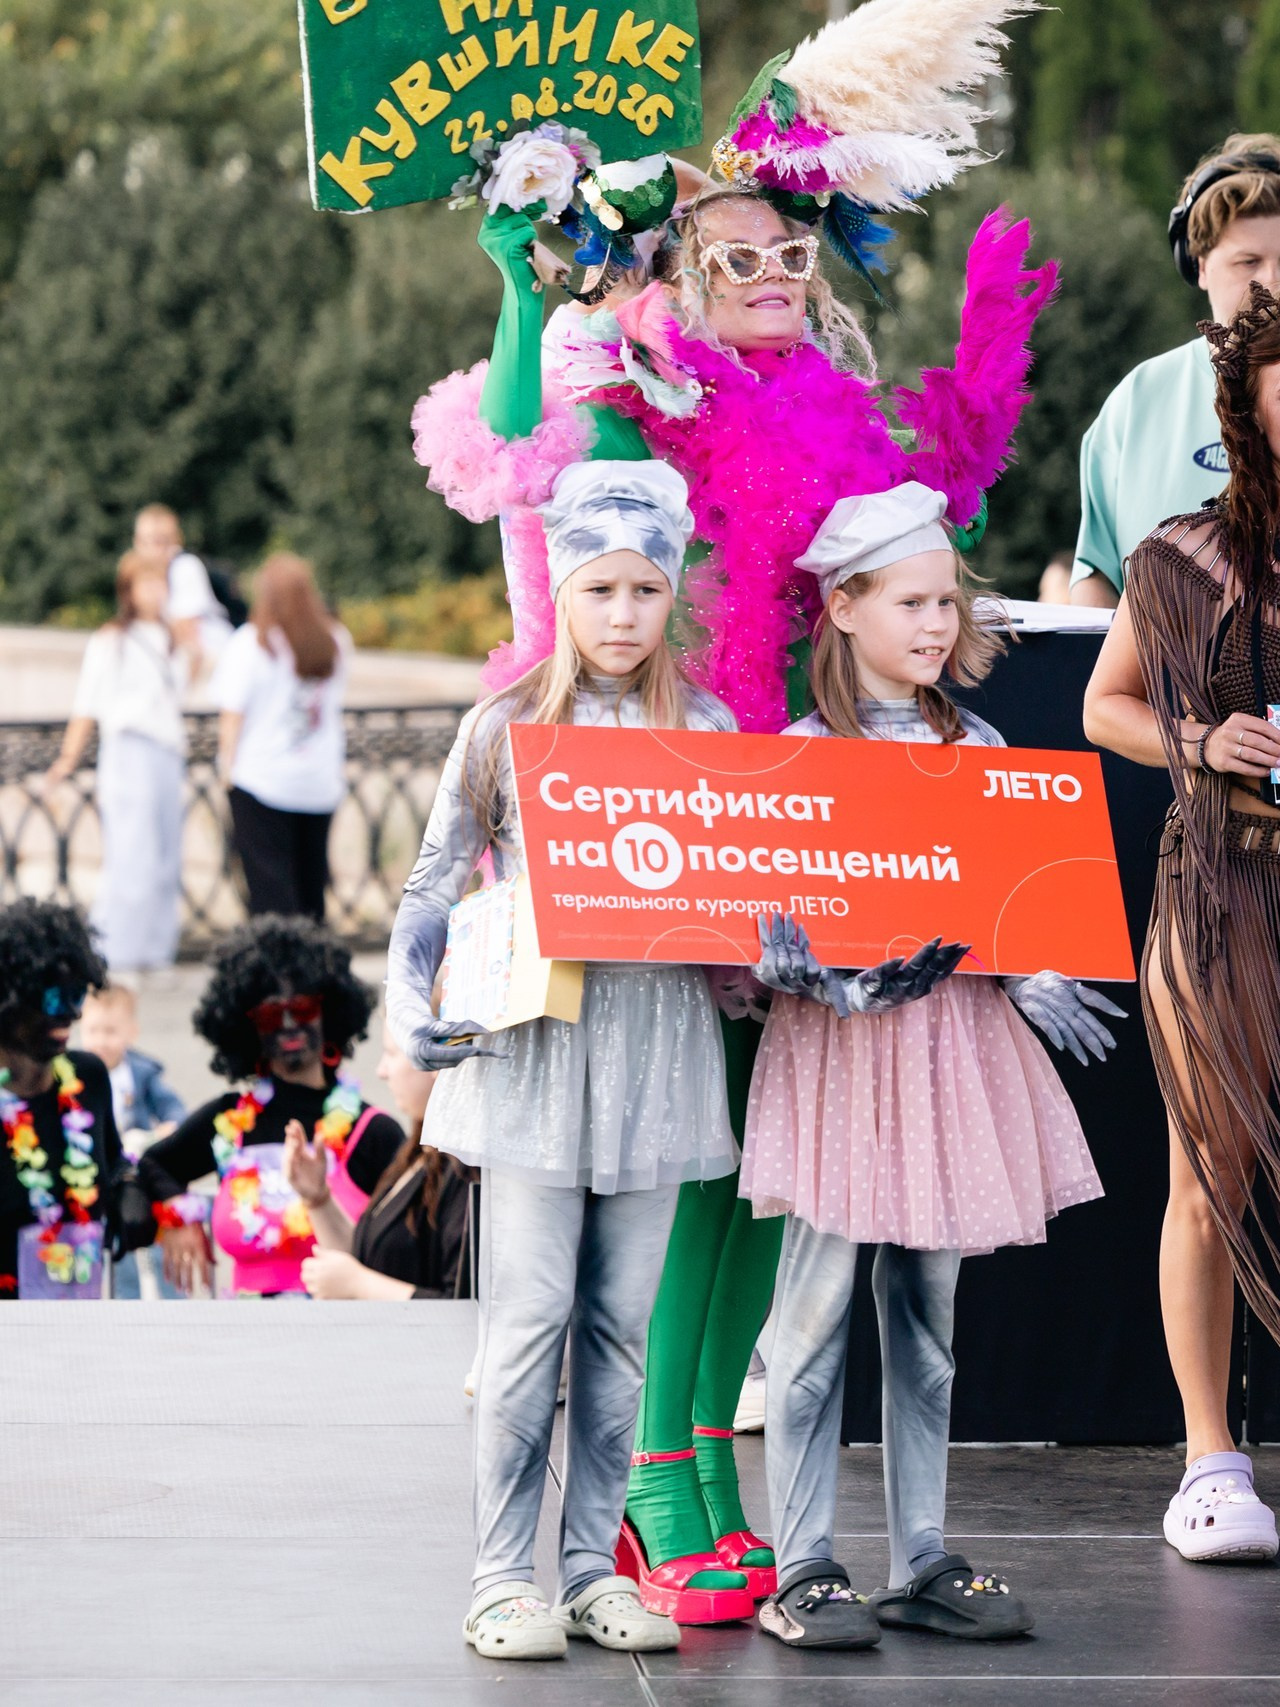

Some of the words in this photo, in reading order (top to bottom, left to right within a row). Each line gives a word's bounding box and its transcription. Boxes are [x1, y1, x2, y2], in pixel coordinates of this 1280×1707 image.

[318, 5, 695, 206] КУВШИНКЕ
[538, 771, 835, 829] Сертификат
[983, 769, 1083, 803] ЛЕТО
[547, 839, 609, 868] на
[624, 838, 669, 874] 10
[687, 844, 960, 884] посещений
[552, 893, 690, 914] термального
[695, 897, 783, 919] курорта
[788, 895, 849, 917] ЛЕТО
